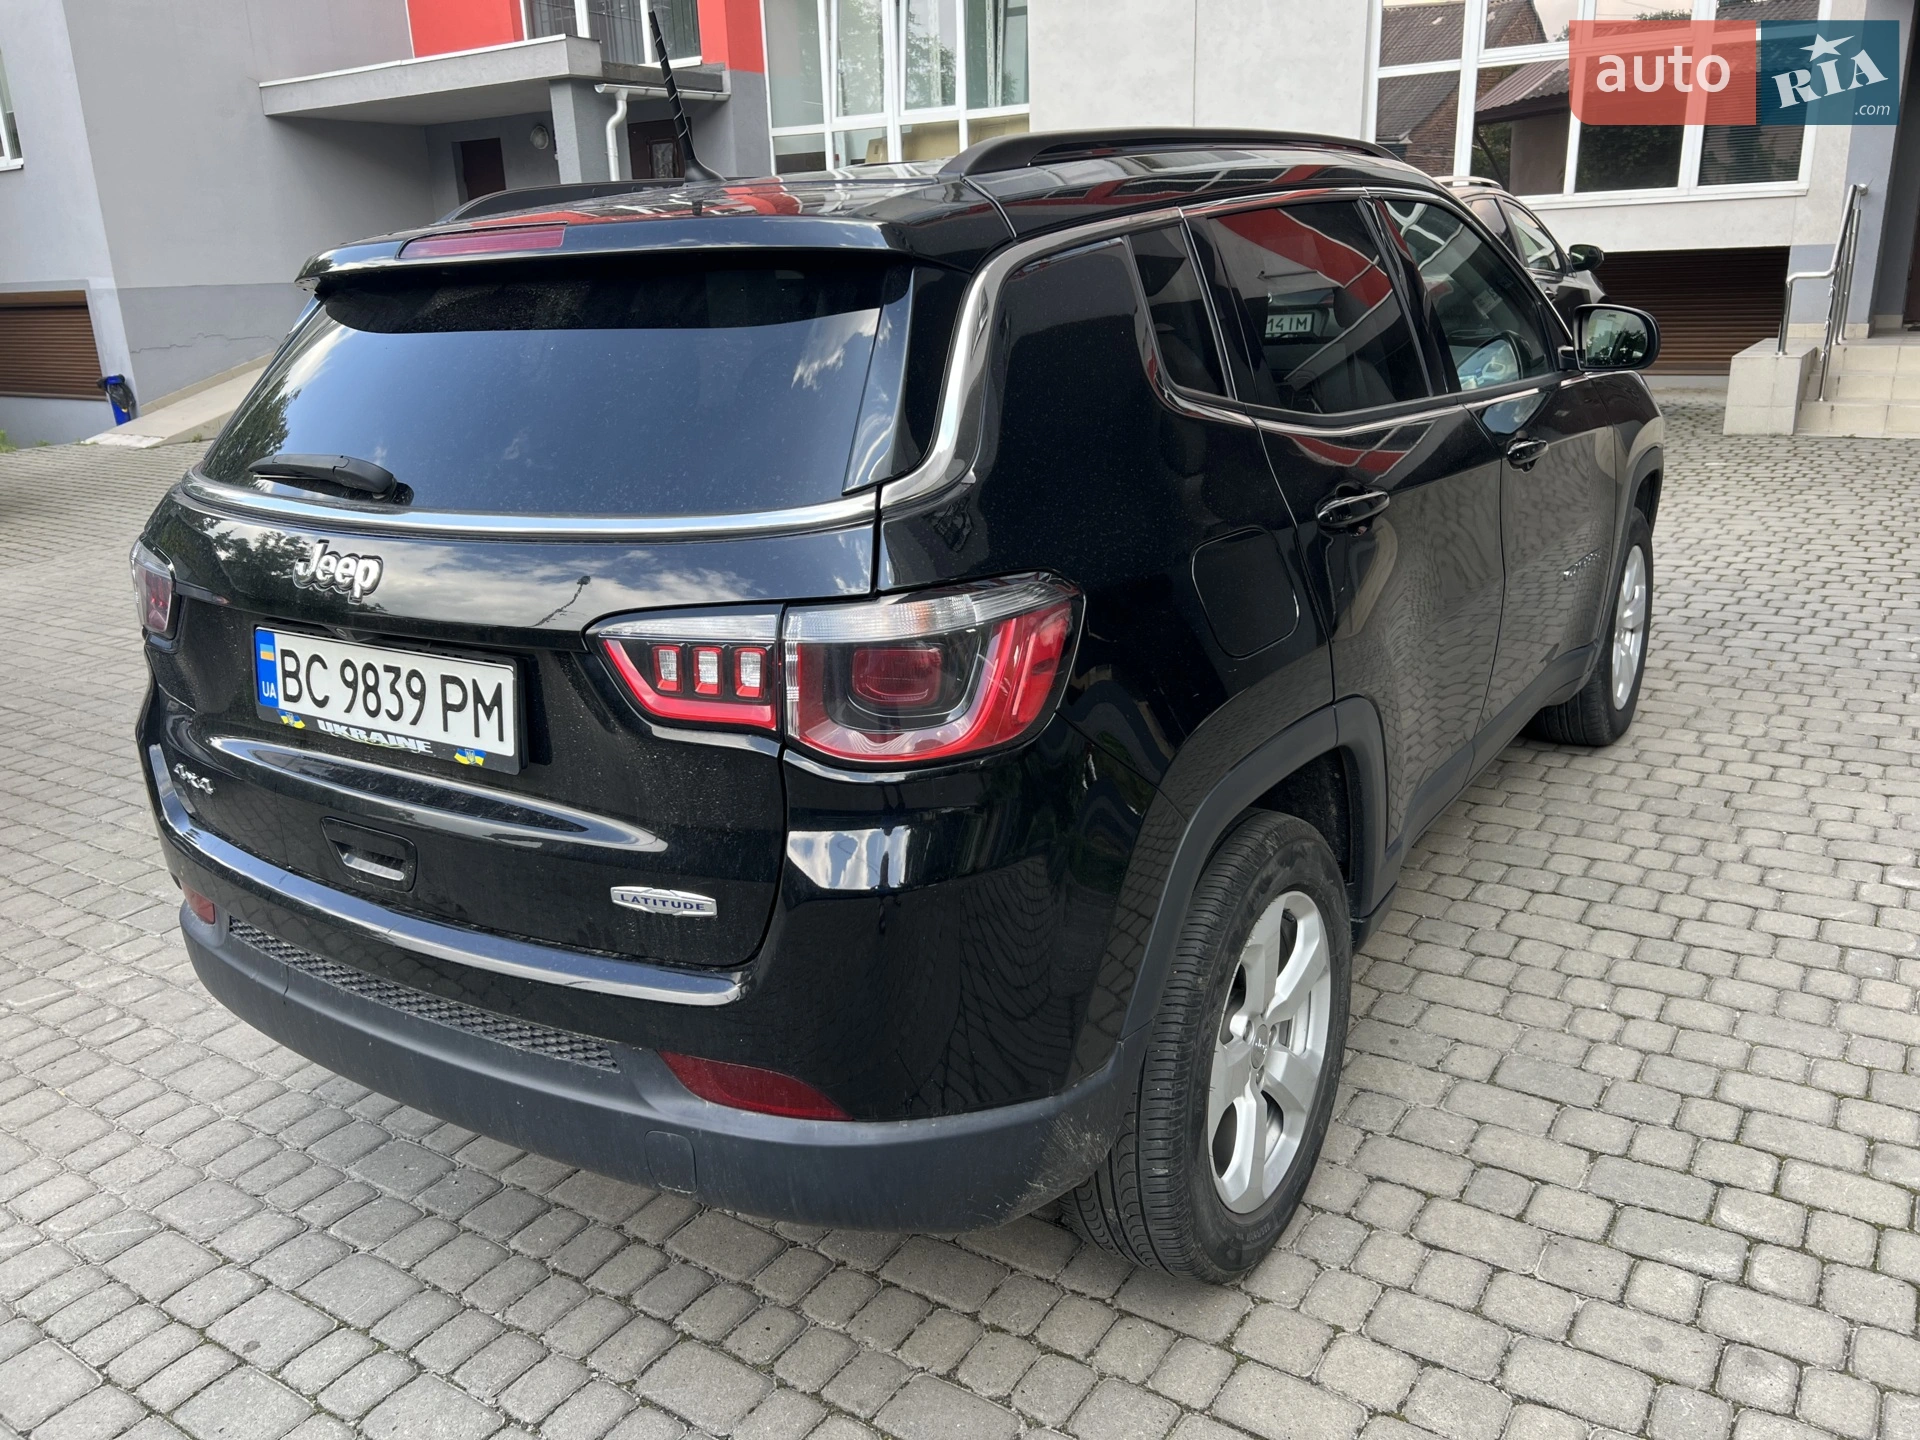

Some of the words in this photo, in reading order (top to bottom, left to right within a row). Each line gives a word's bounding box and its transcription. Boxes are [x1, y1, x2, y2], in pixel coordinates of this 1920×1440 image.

[294, 539, 383, 604] Jeep
[262, 680, 277, 699] UA
[280, 649, 330, 708] BC
[339, 658, 427, 726] 9839
[440, 673, 504, 742] PM
[317, 719, 433, 753] UKRAINE
[620, 894, 705, 911] LATITUDE
